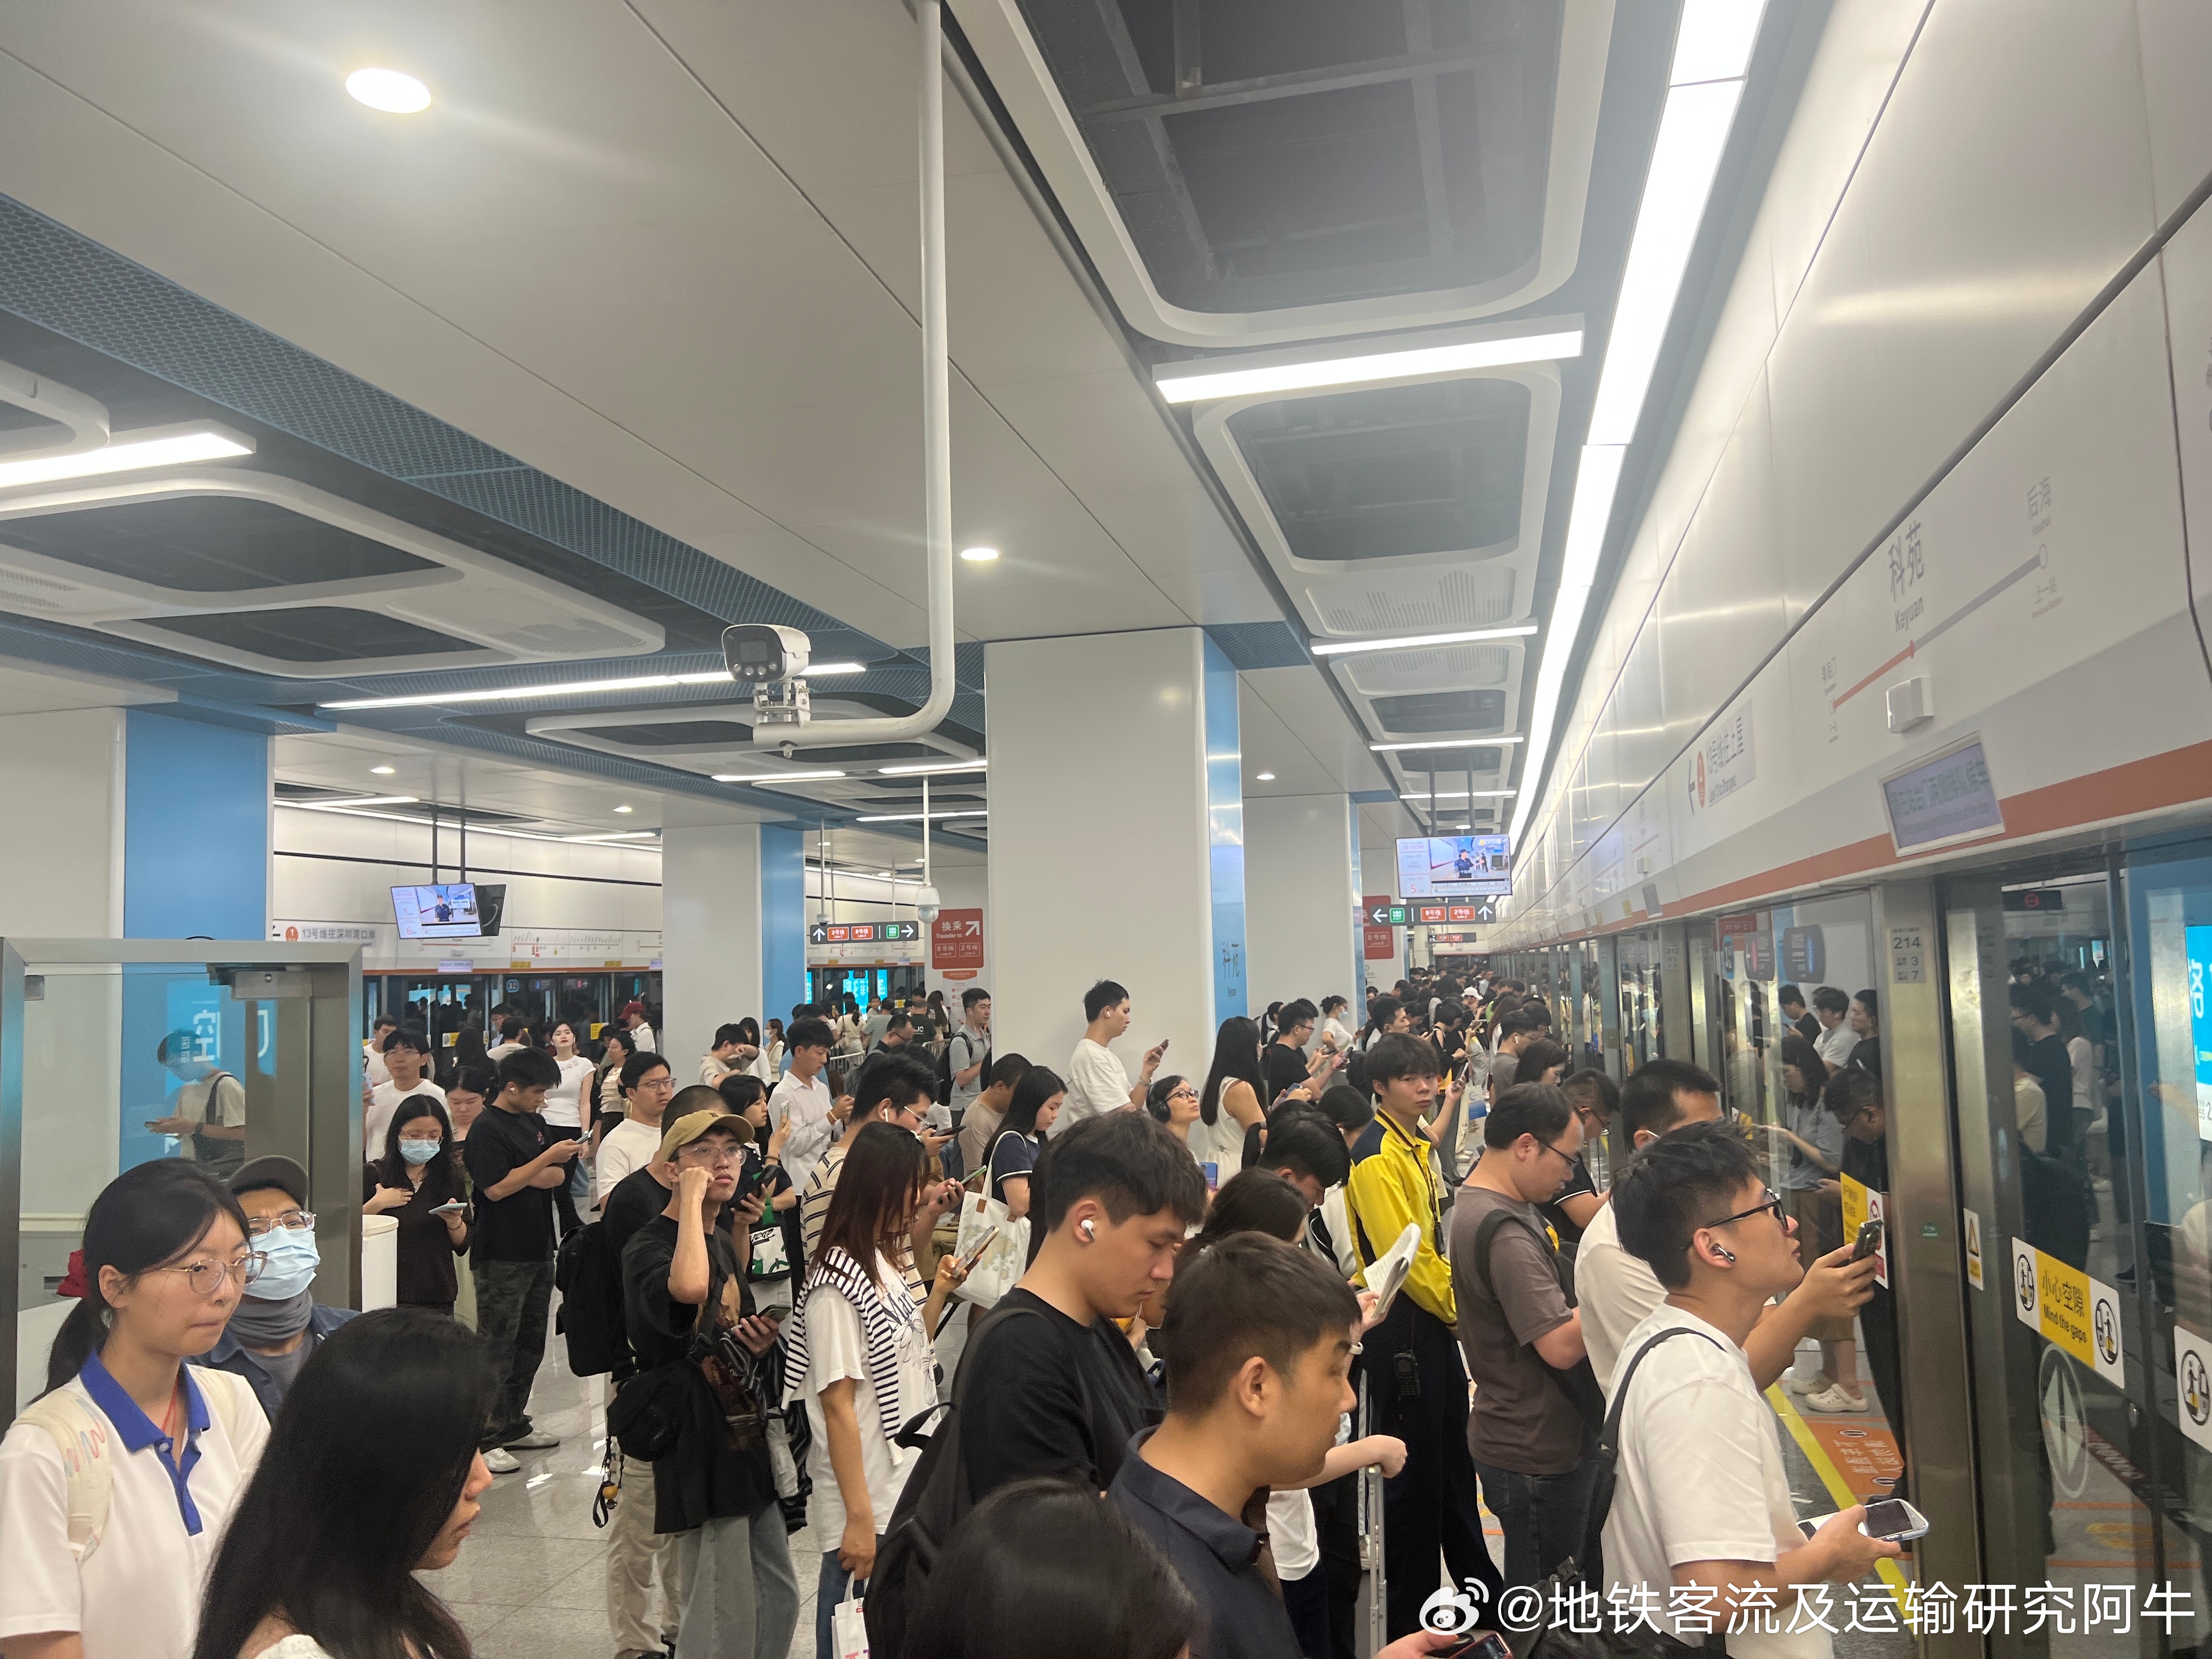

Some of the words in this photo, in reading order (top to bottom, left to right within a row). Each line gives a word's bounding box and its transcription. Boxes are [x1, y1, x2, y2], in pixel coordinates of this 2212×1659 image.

[2027, 475, 2051, 521] 后海
[1888, 520, 1924, 602] 科苑
[1894, 597, 1924, 633] Keyuan
[1410, 884, 1417, 894] 5
[942, 921, 962, 932] 换乘
[302, 928, 376, 940] 13号线往深圳湾口岸
[1893, 936, 1921, 949] 214
[1911, 956, 1918, 966] 3
[1912, 970, 1919, 980] 7
[2042, 1269, 2085, 1317] 小心空隙
[2044, 1304, 2058, 1325] Mind
[2059, 1313, 2069, 1333] the
[2071, 1324, 2086, 1344] gaps
